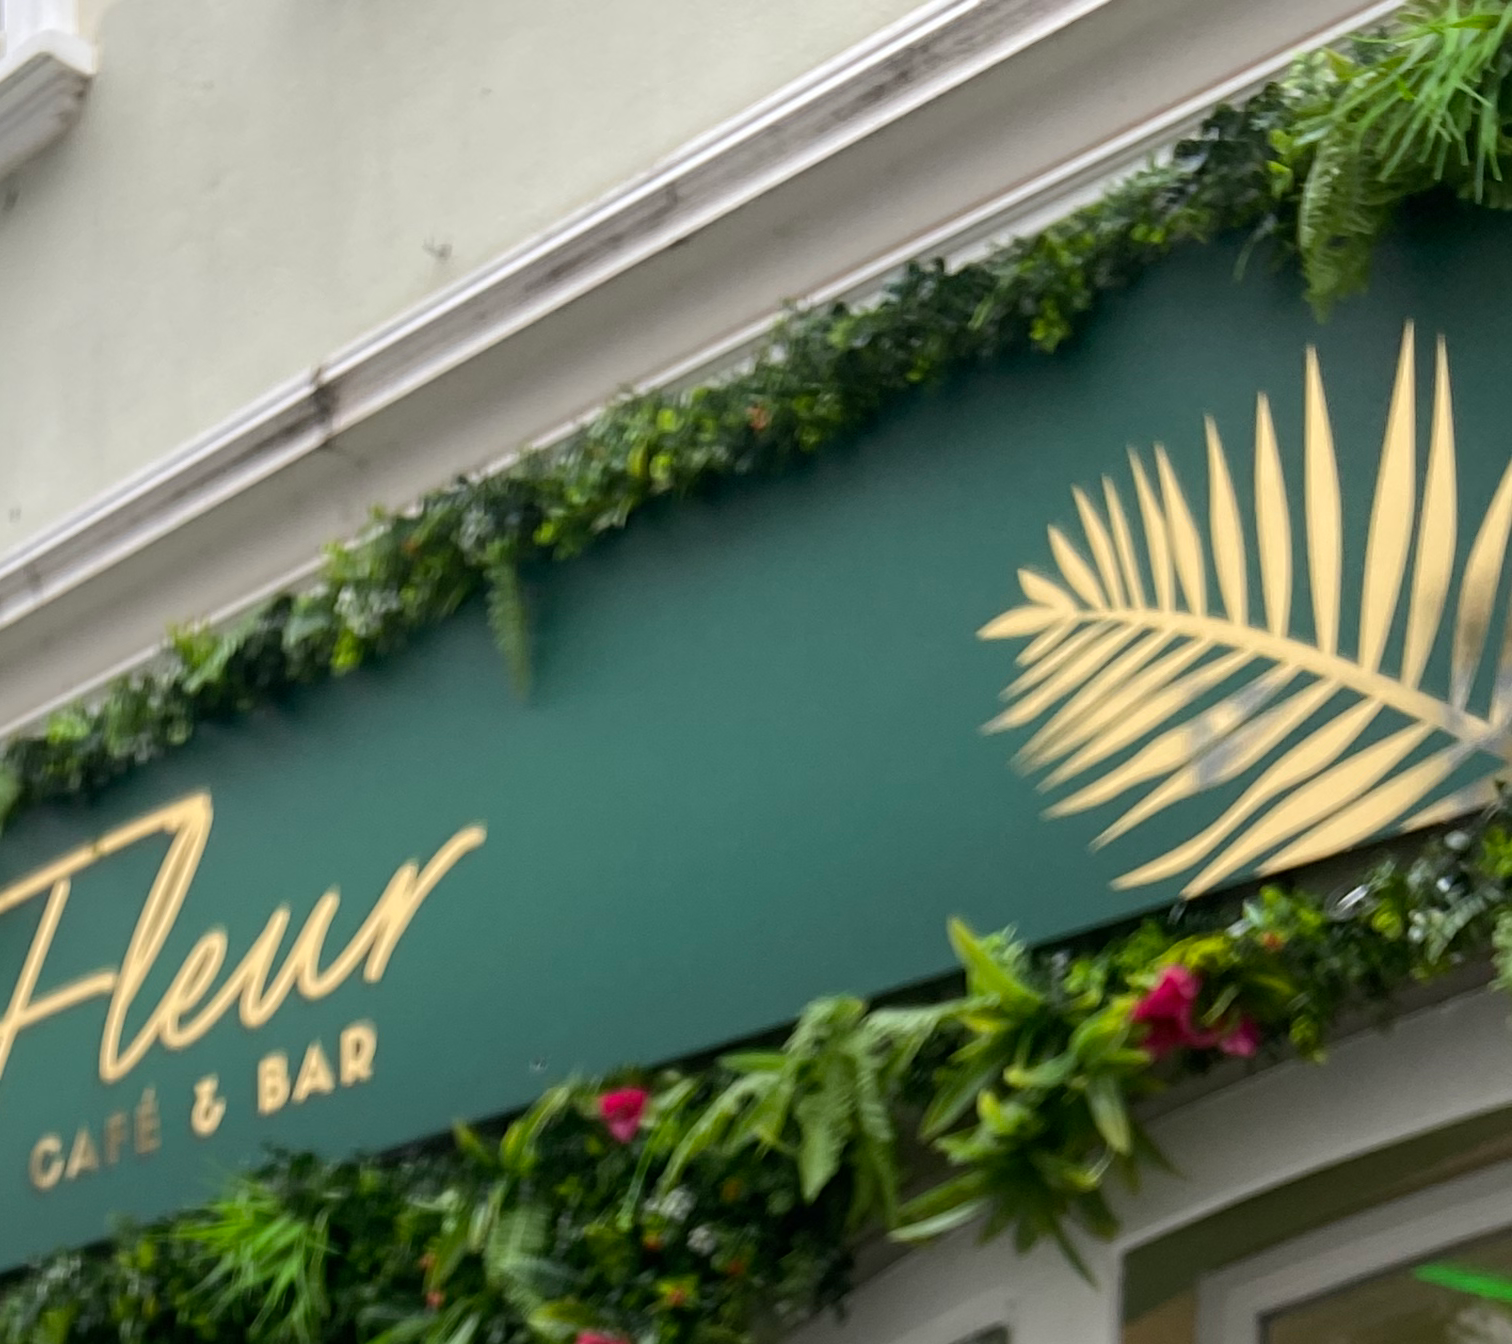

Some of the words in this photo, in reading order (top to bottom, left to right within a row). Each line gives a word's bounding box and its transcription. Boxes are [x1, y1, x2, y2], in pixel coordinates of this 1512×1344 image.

[29, 1084, 162, 1190] CAFÉ
[190, 1073, 226, 1138] &
[256, 1018, 377, 1116] BAR
